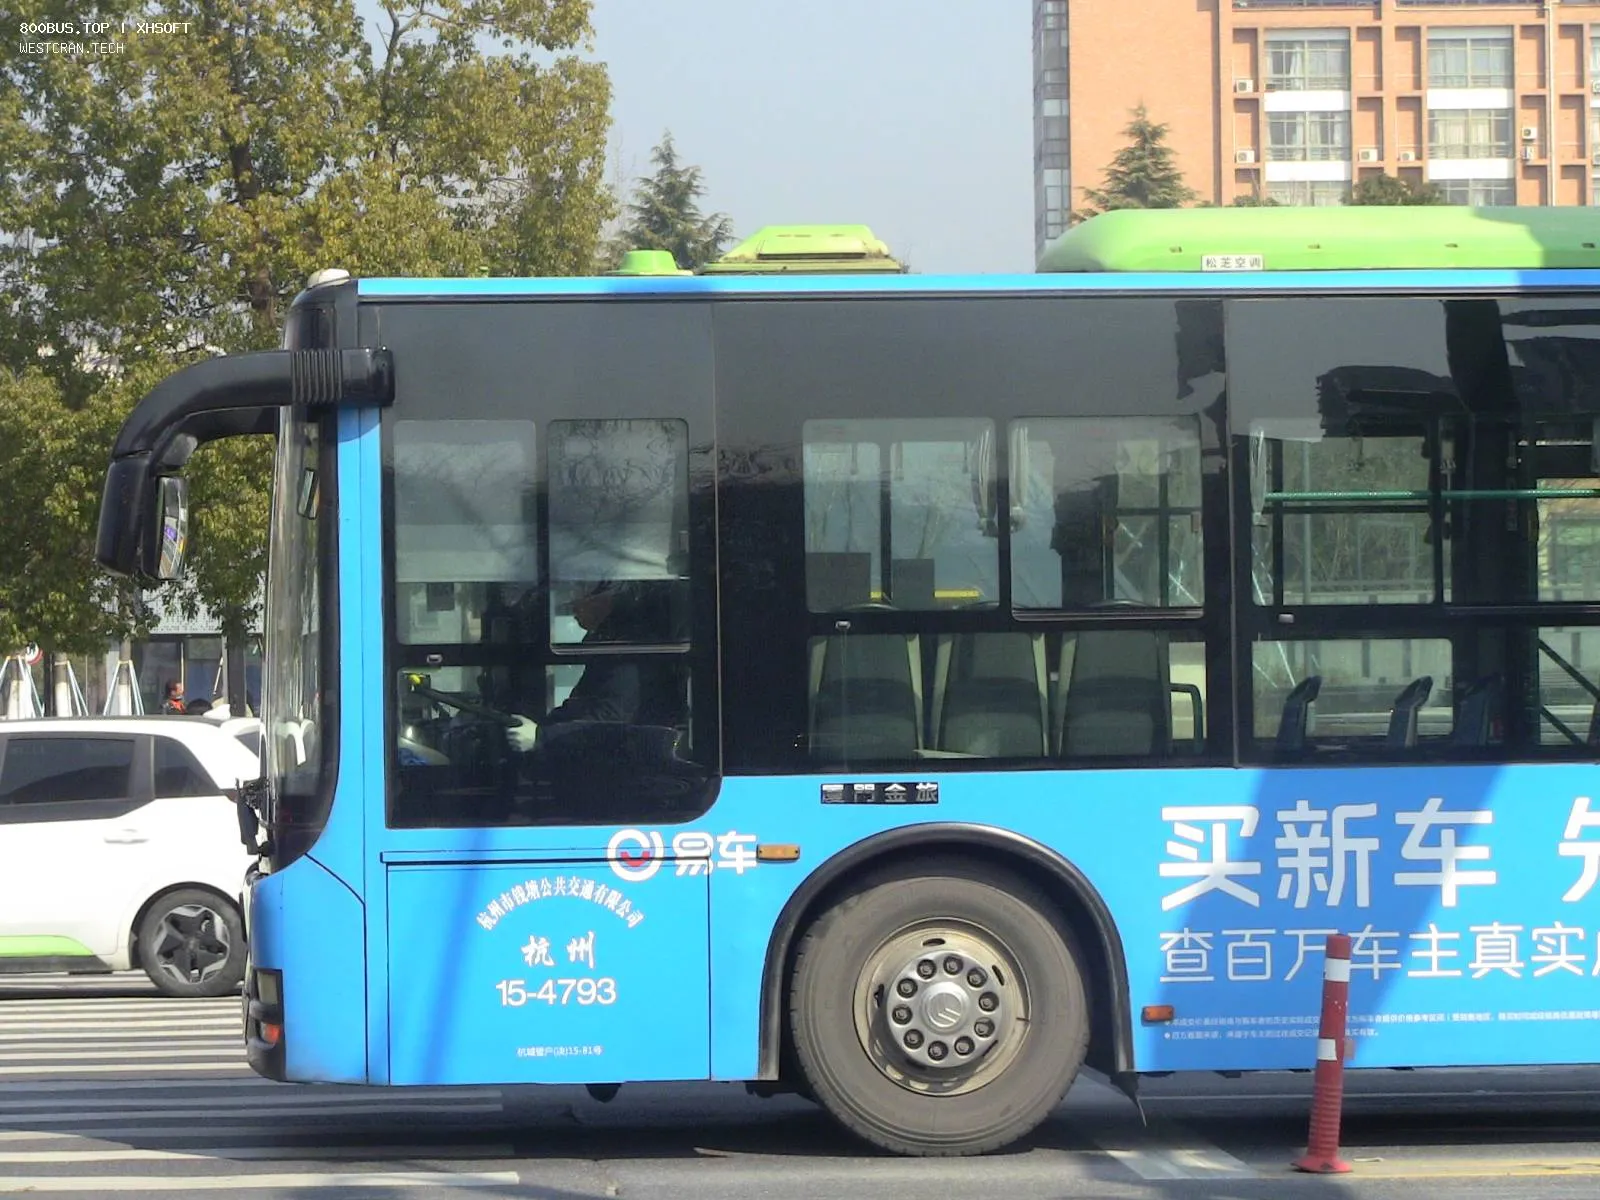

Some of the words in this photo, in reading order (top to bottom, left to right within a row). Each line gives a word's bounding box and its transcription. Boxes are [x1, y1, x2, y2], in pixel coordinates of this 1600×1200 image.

[1205, 256, 1262, 269] 松芝空调
[672, 830, 757, 877] 易车
[1159, 797, 1497, 911] 买新车
[1159, 920, 1600, 983] 查百万车主真实
[495, 977, 617, 1007] 15-4793
